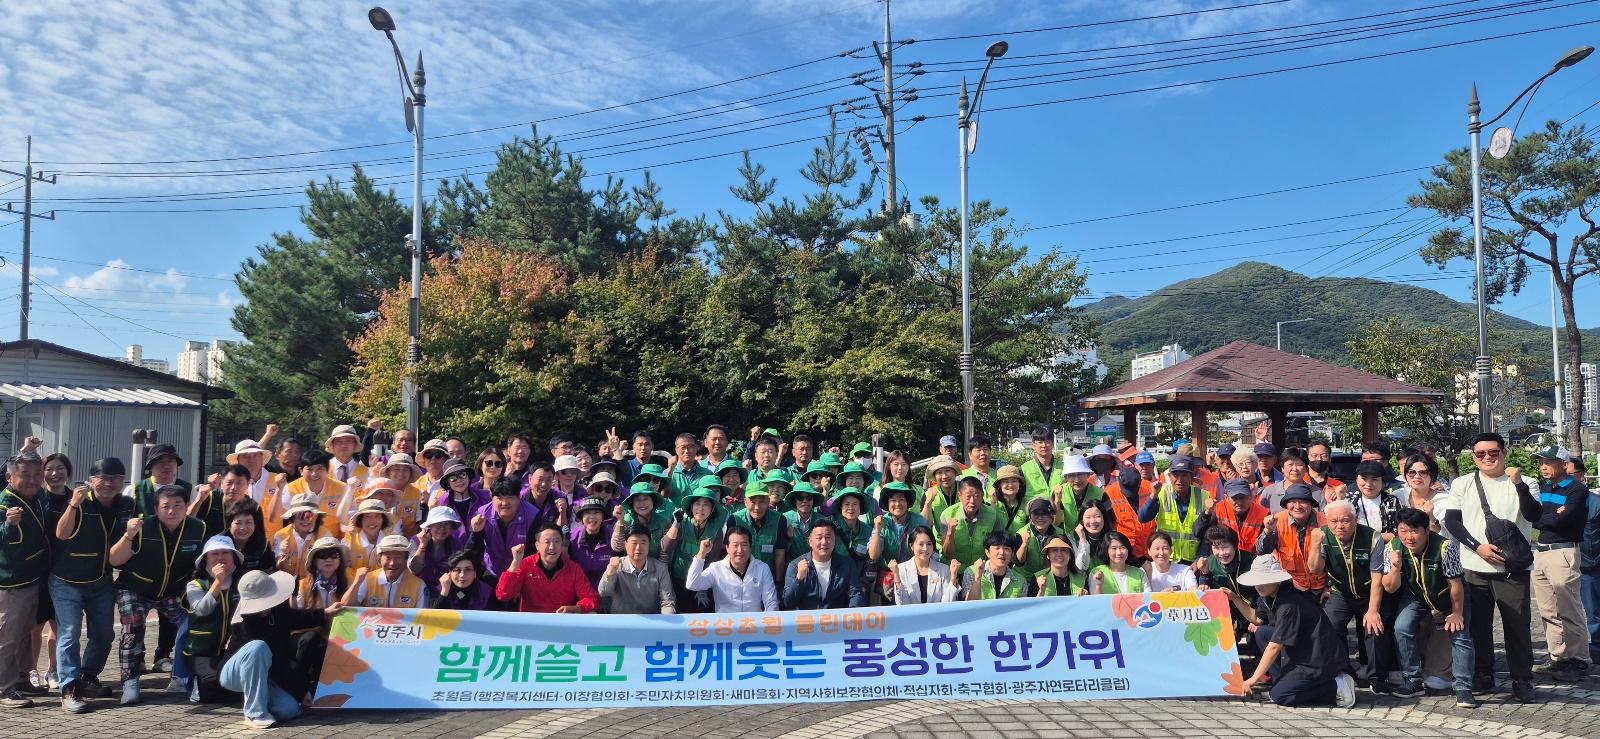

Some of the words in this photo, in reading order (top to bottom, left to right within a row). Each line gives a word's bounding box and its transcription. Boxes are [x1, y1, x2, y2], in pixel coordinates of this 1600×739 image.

[375, 624, 422, 639] 광주시
[688, 615, 783, 637] 상상초월
[794, 611, 886, 634] 클린데이
[436, 644, 627, 683] 함께쓸고
[645, 641, 827, 682] 함께웃는
[843, 634, 974, 678] 풍성한
[988, 629, 1125, 673] 한가위
